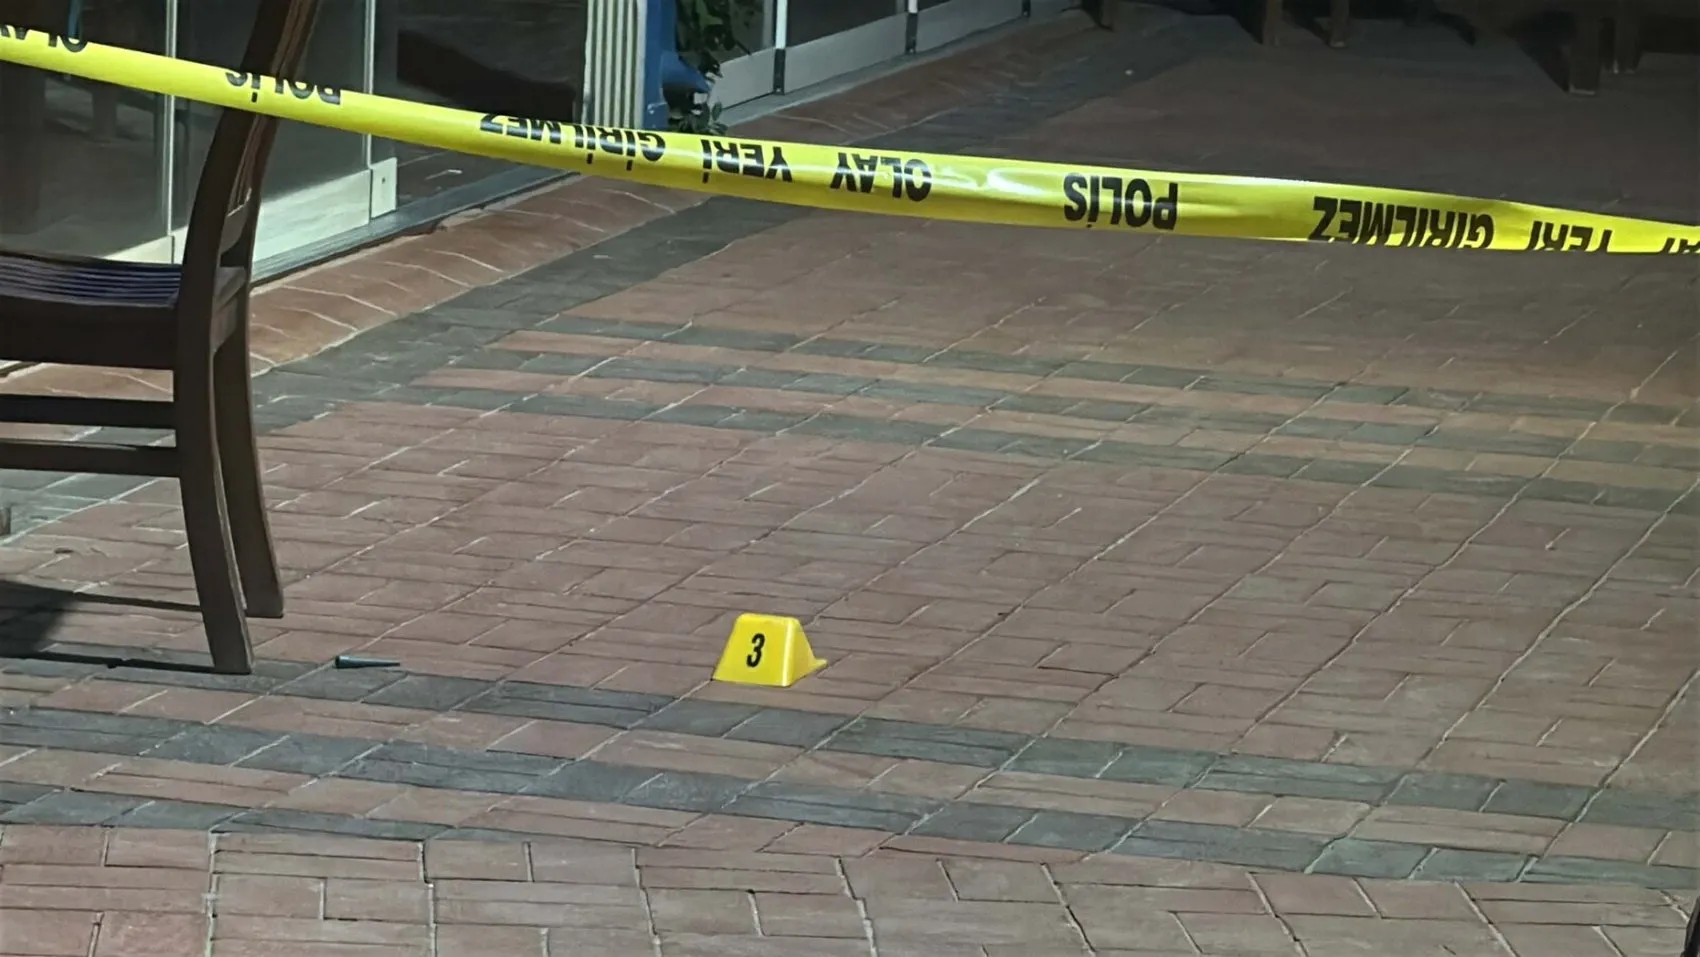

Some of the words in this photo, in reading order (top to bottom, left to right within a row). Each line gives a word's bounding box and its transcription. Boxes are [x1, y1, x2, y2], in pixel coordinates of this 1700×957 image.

[700, 138, 793, 184] YERİ
[829, 151, 932, 202] OLAY
[1063, 172, 1179, 231] POLİS
[746, 632, 766, 668] 3
